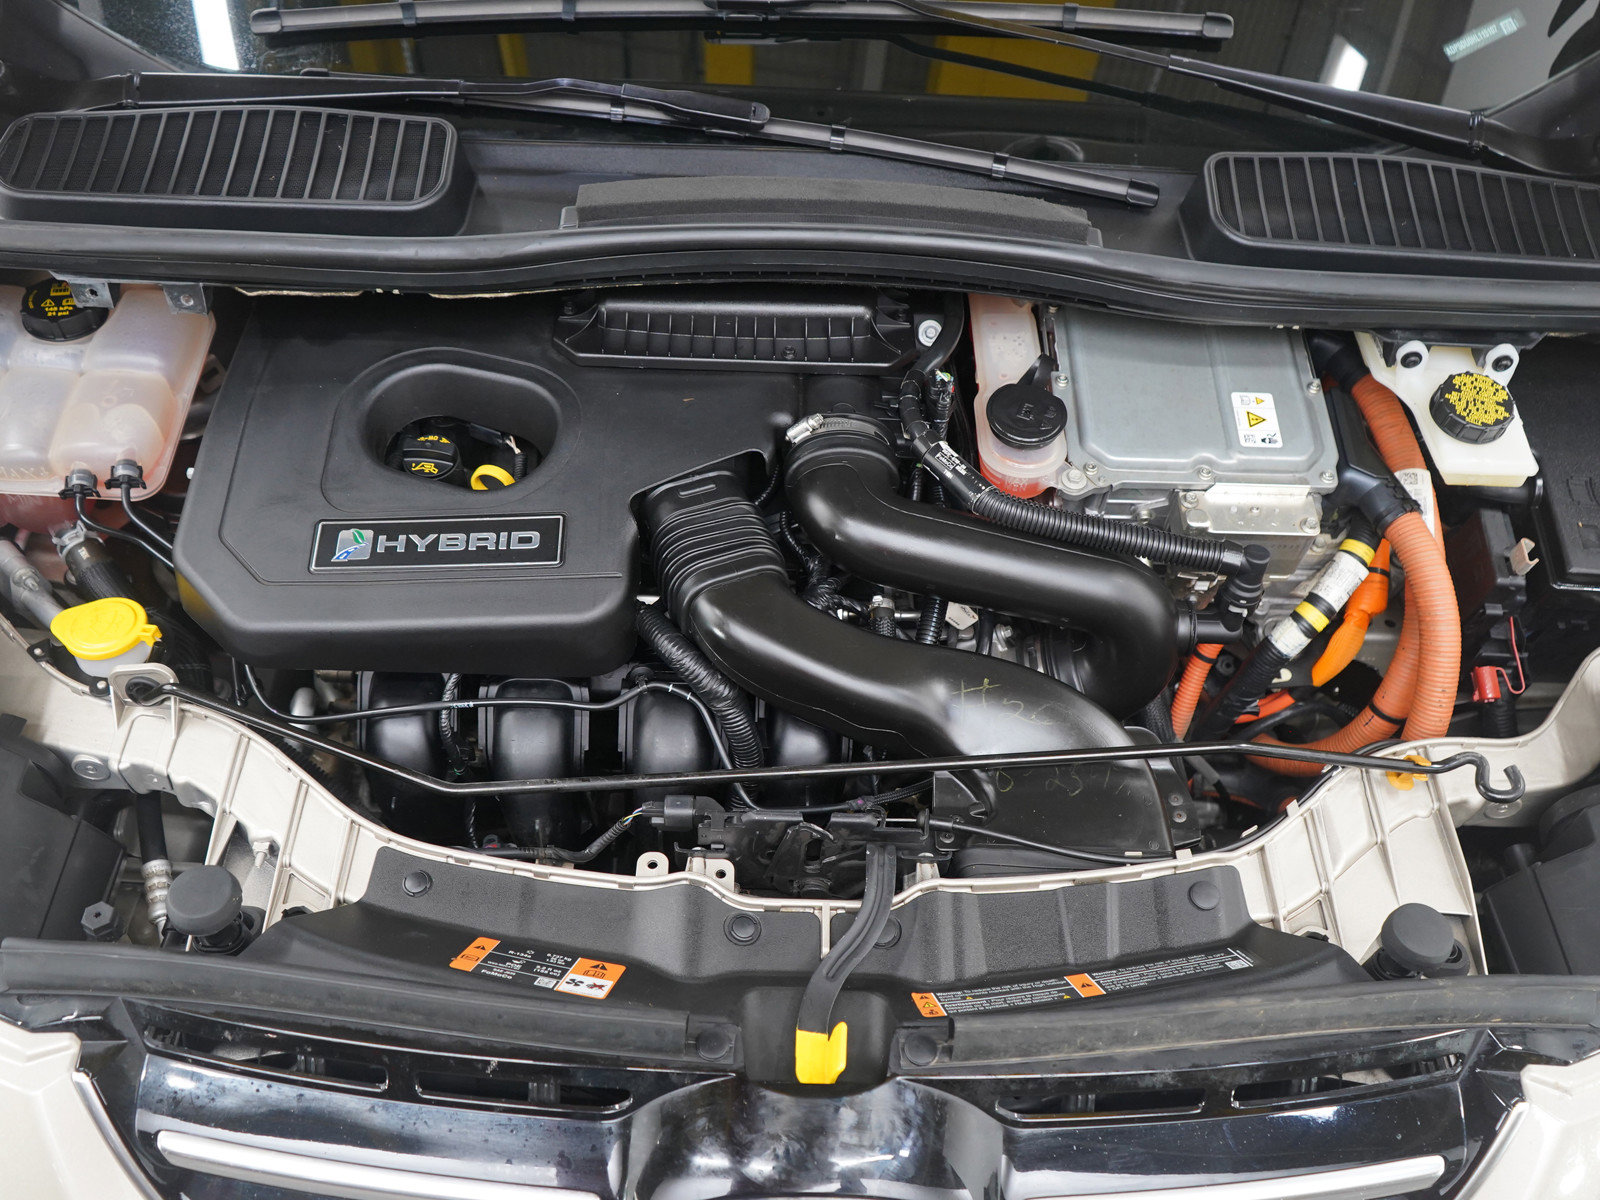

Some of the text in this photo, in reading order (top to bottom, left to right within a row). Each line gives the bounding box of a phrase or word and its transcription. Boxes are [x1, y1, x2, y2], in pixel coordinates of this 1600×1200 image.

[376, 531, 540, 552] HYBRID
[508, 950, 532, 958] R-134a
[481, 969, 512, 979] FoMoCo
